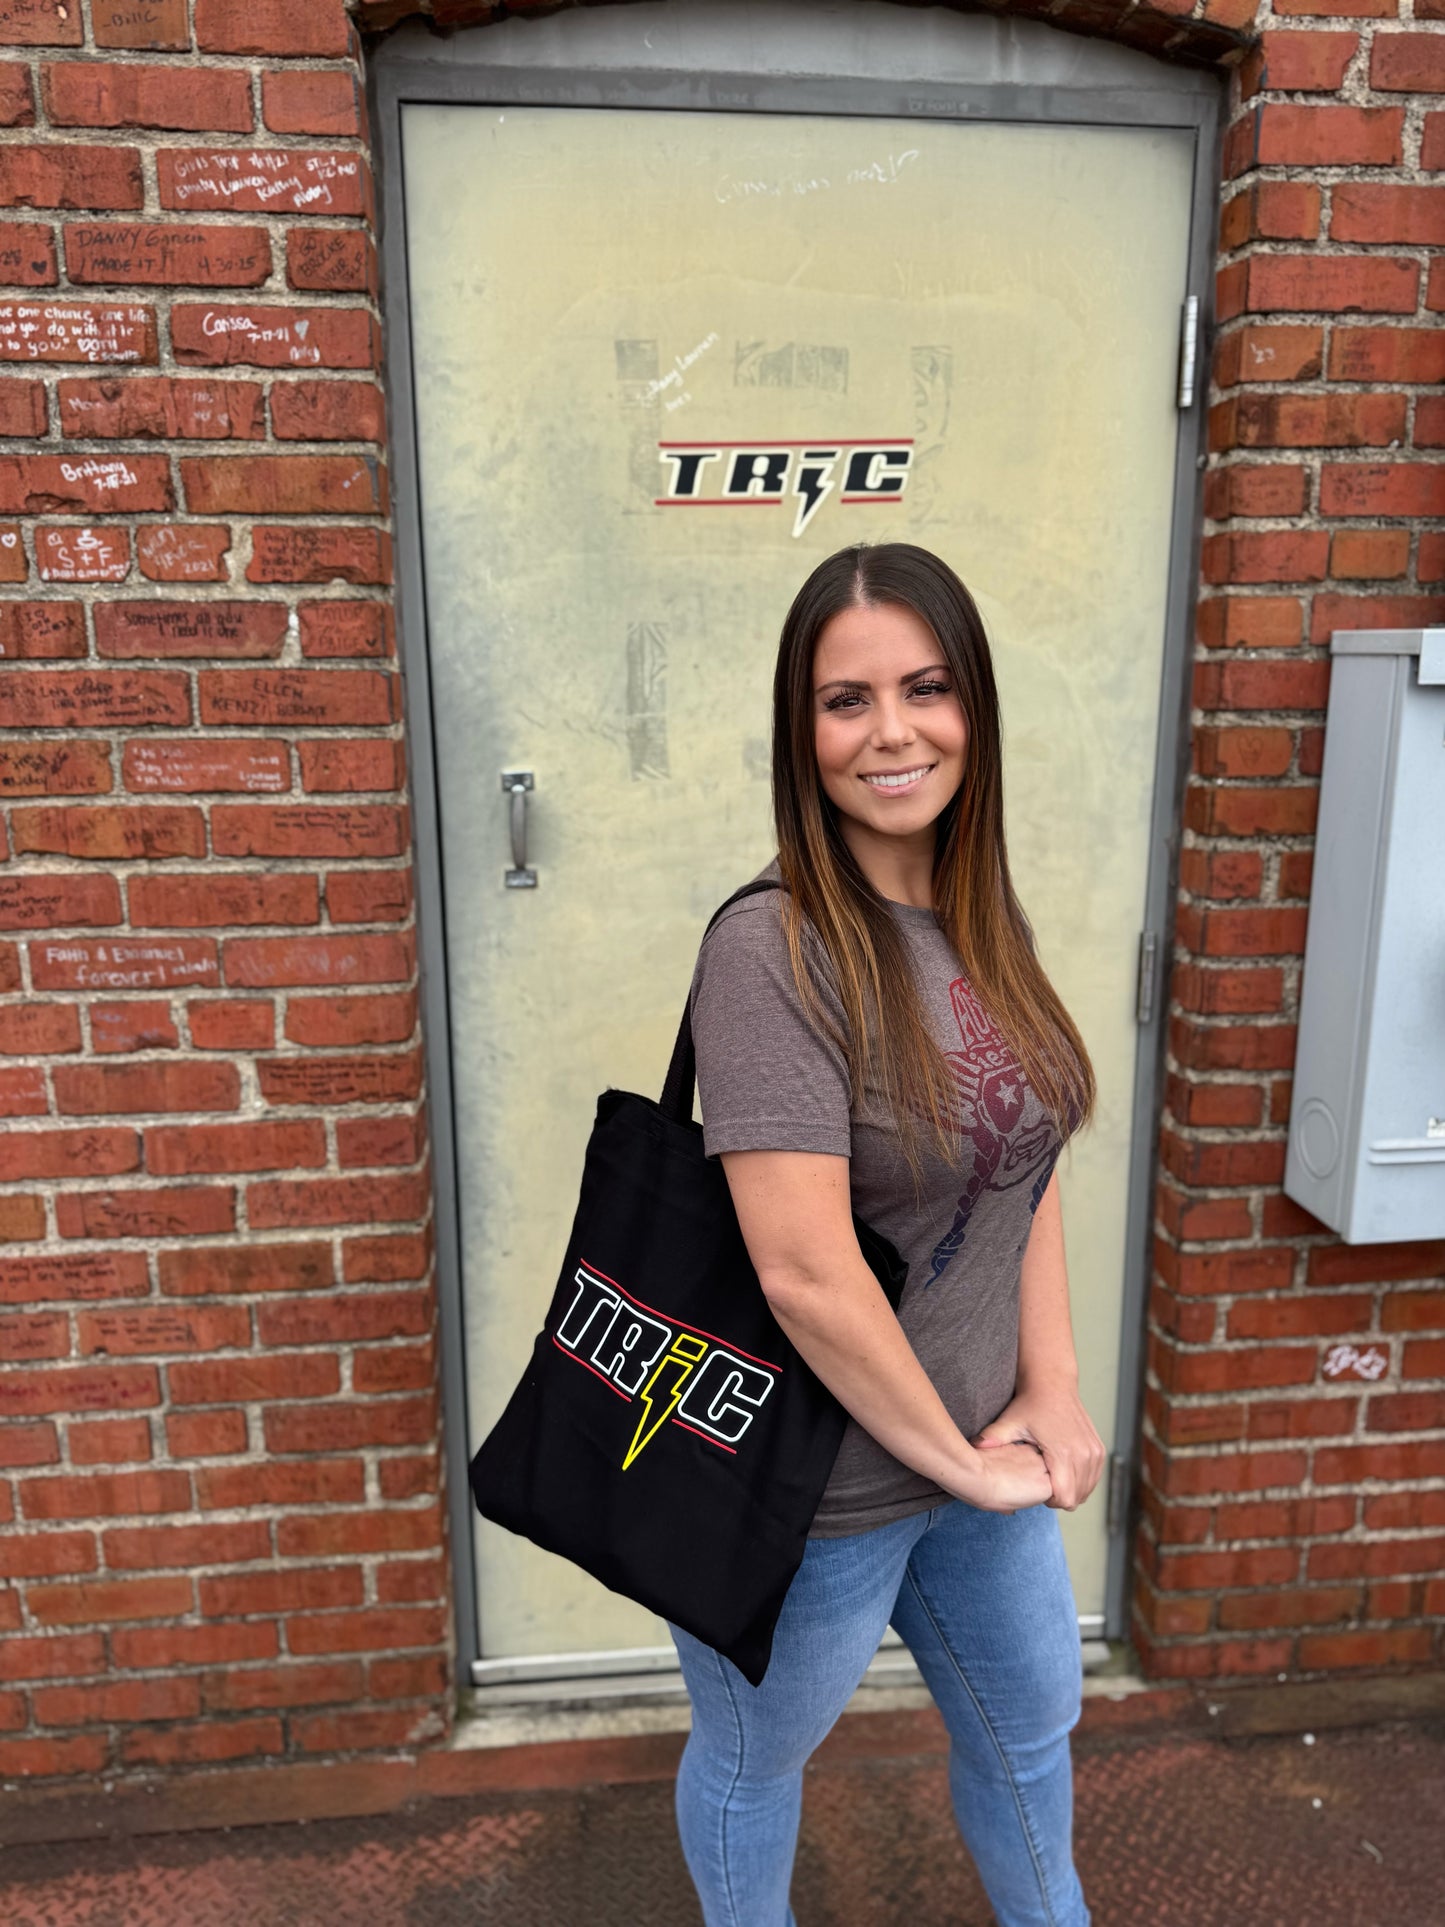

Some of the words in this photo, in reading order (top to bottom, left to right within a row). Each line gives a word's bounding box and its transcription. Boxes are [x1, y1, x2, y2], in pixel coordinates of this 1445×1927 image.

[76, 228, 141, 249] DANNY
[47, 320, 66, 336] do
[8, 339, 21, 350] to
